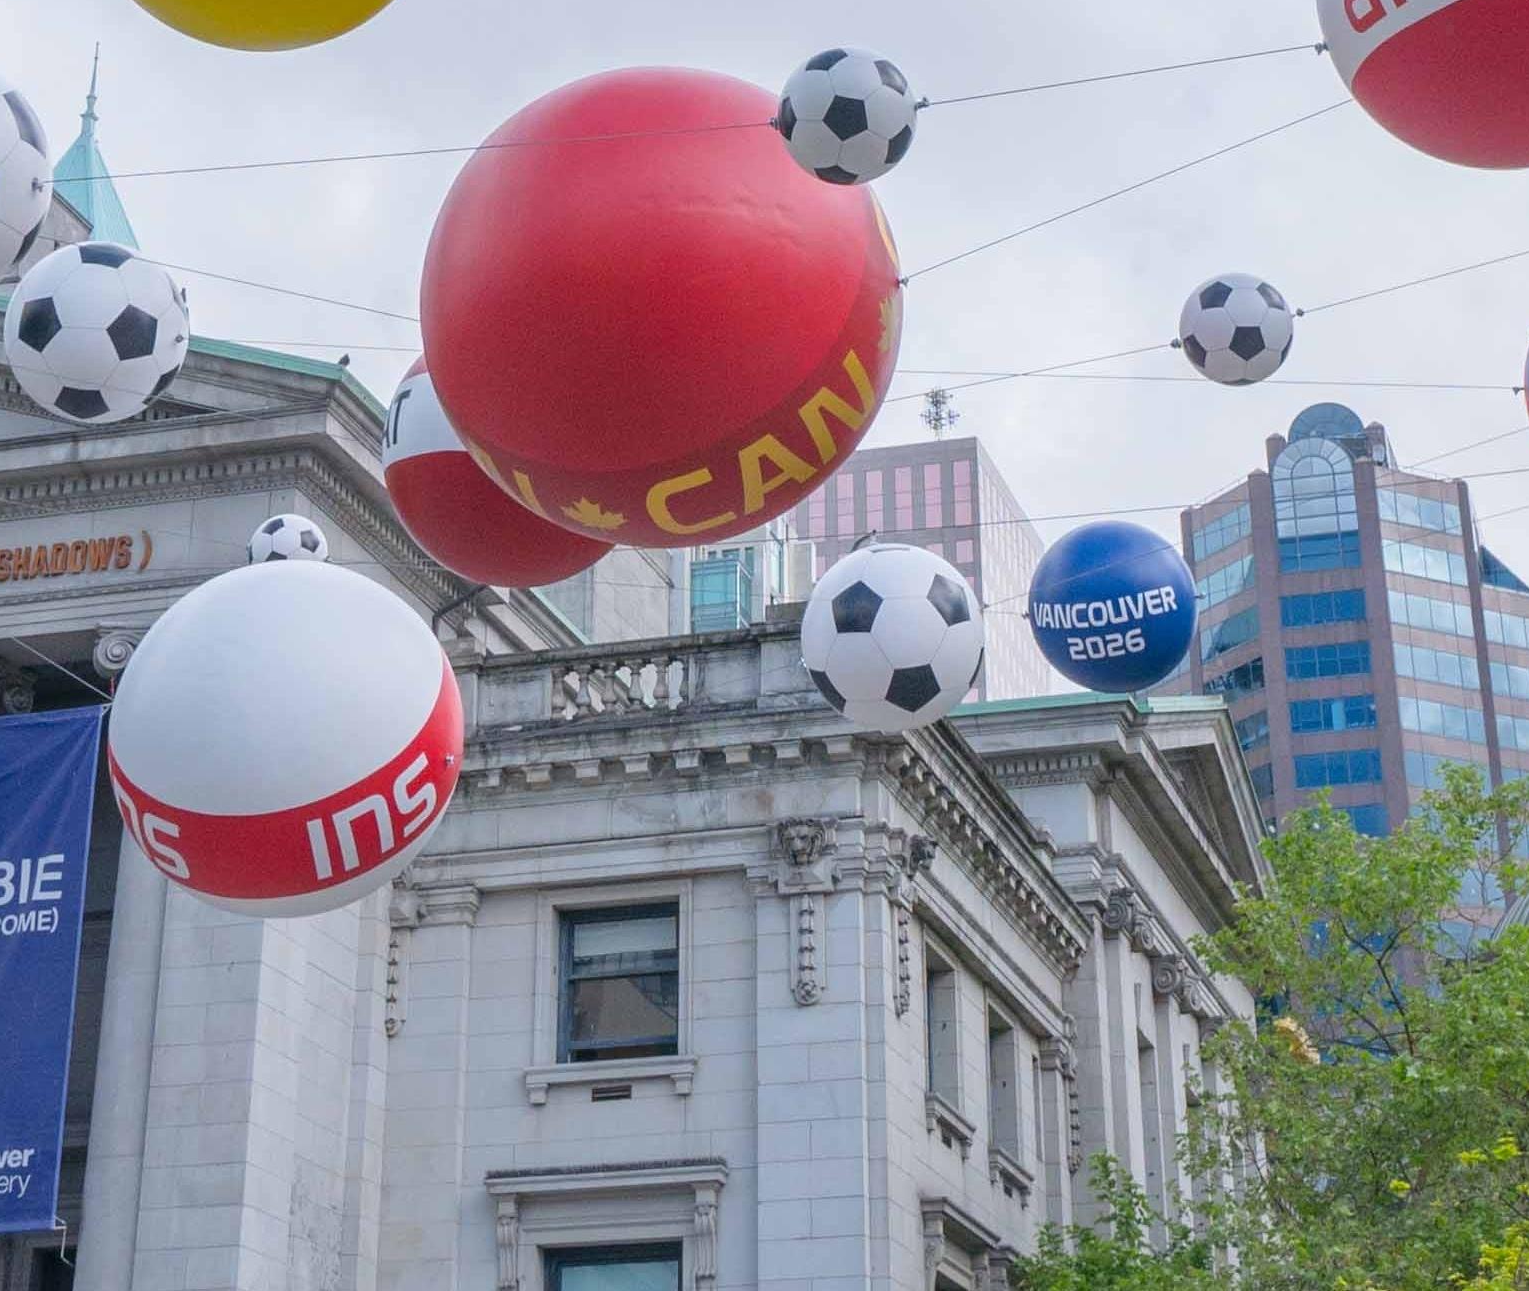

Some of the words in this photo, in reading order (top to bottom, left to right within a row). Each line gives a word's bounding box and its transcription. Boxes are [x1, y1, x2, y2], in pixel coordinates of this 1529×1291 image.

[645, 349, 875, 535] CAN
[1033, 585, 1178, 629] VANCOUVER
[1067, 628, 1146, 660] 2026
